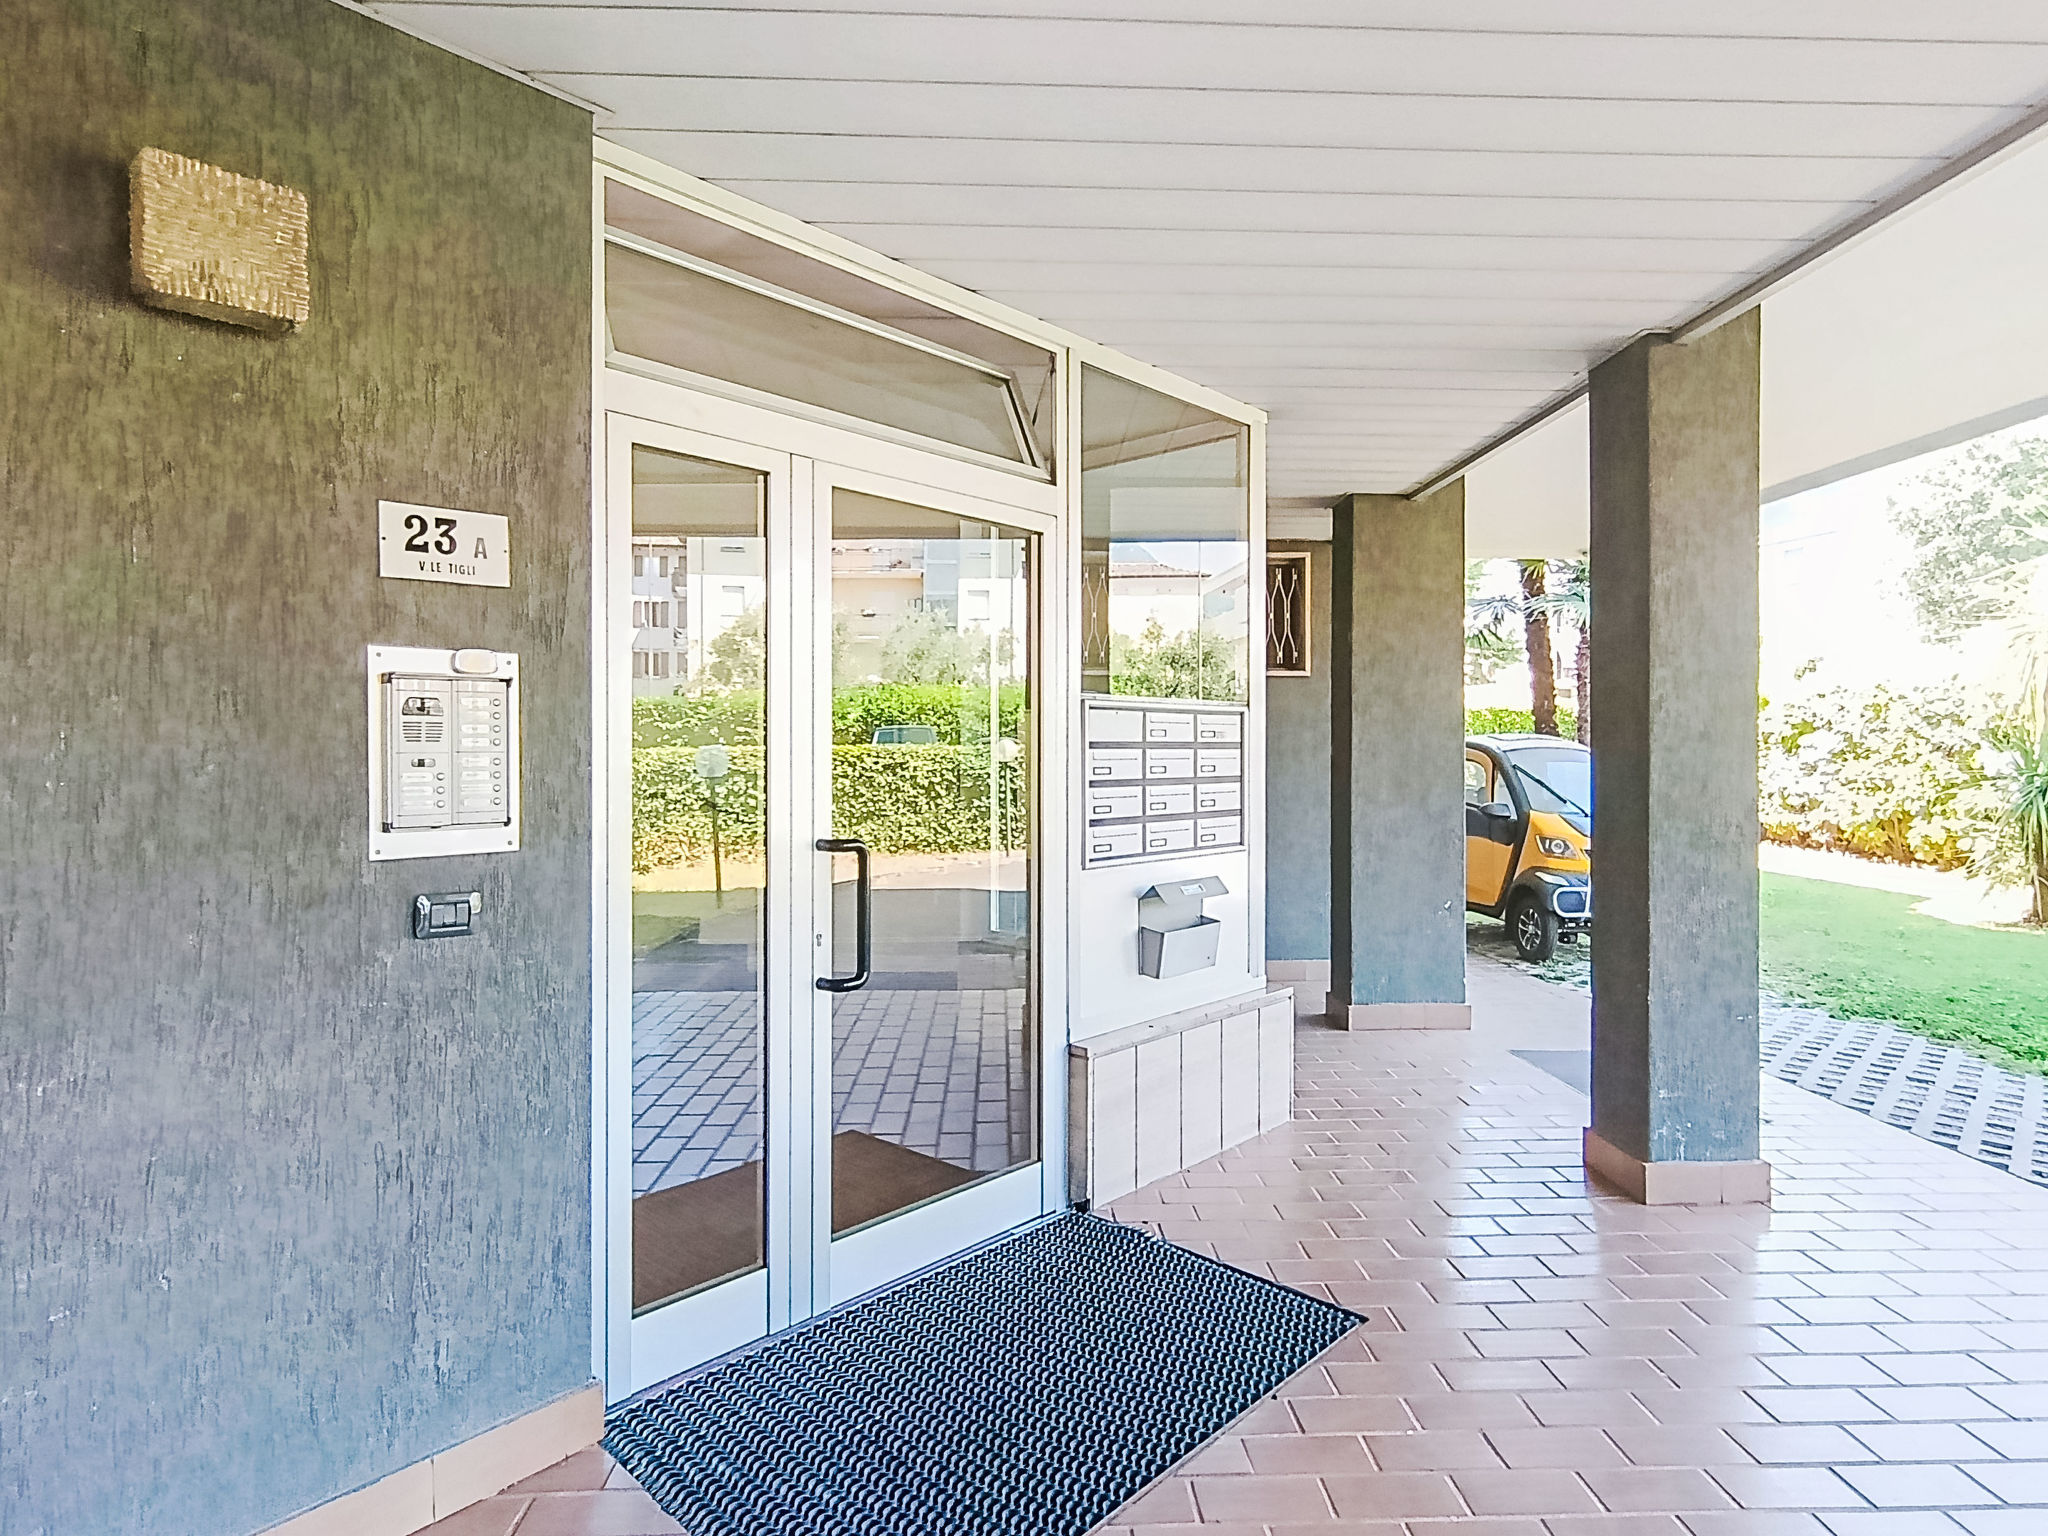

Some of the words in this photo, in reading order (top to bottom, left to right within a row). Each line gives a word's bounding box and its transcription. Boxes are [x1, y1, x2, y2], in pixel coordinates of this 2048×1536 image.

[404, 514, 457, 555] 23
[474, 538, 488, 559] A
[448, 563, 476, 576] TIGLI
